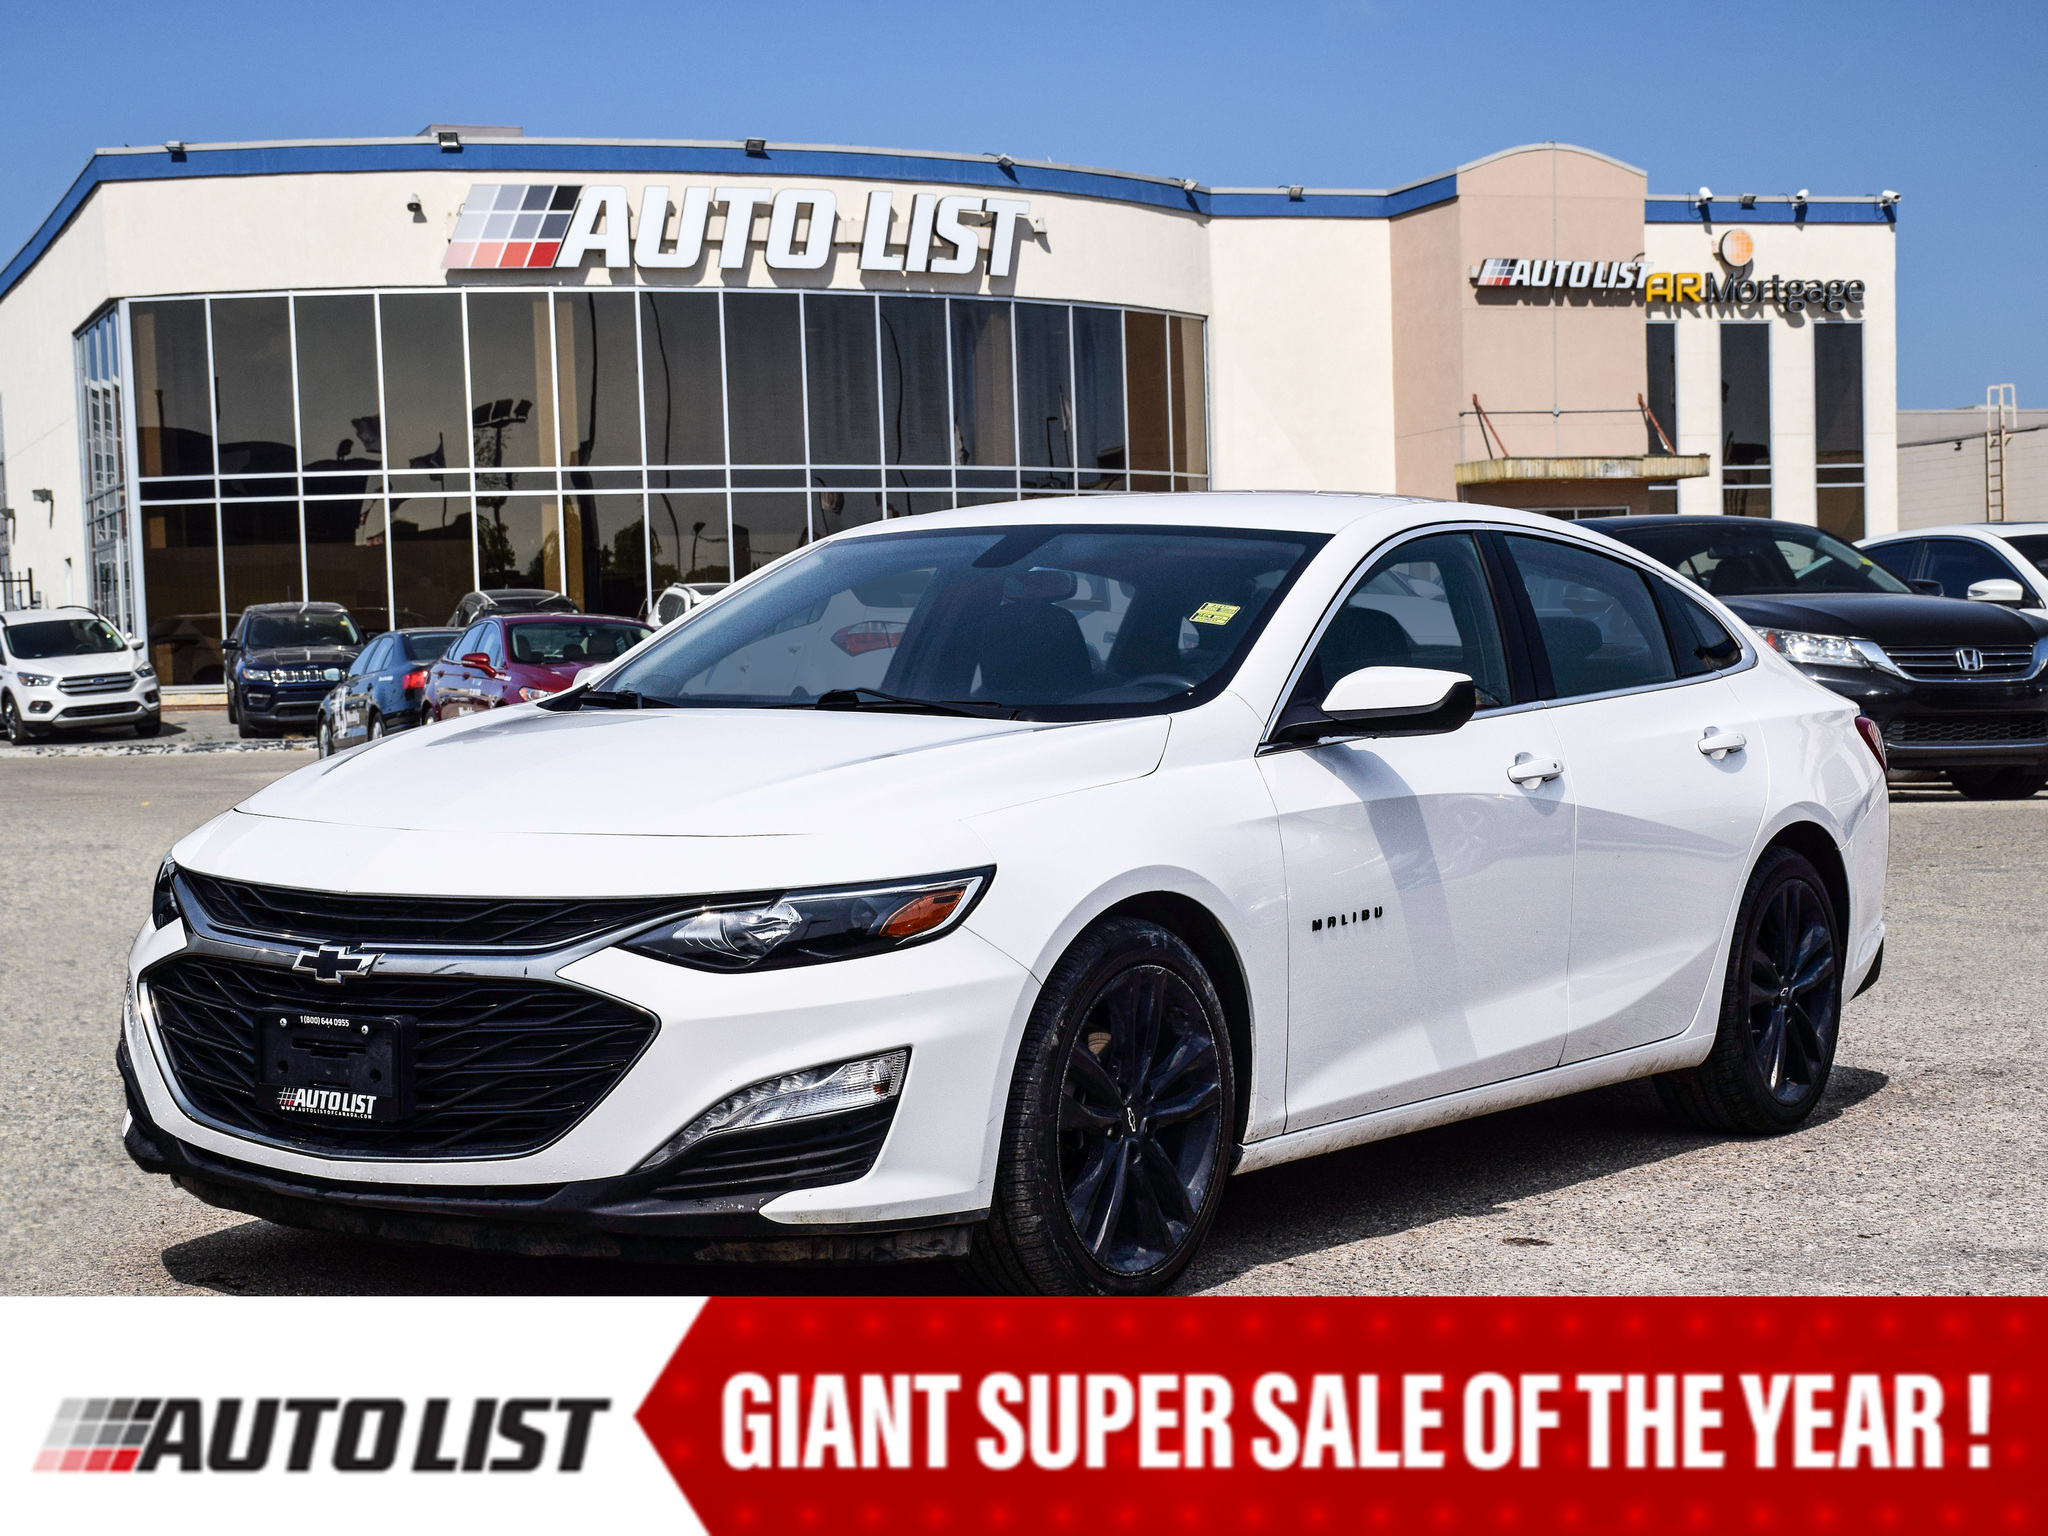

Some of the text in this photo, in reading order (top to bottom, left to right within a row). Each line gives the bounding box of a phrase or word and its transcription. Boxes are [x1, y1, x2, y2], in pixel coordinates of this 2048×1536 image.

[555, 185, 1031, 278] AUTO LIST
[1508, 258, 1655, 290] AUTO LIST
[1311, 905, 1384, 932] MALIBU
[333, 1018, 350, 1027] 0955
[294, 1088, 377, 1115] AUTO LIST
